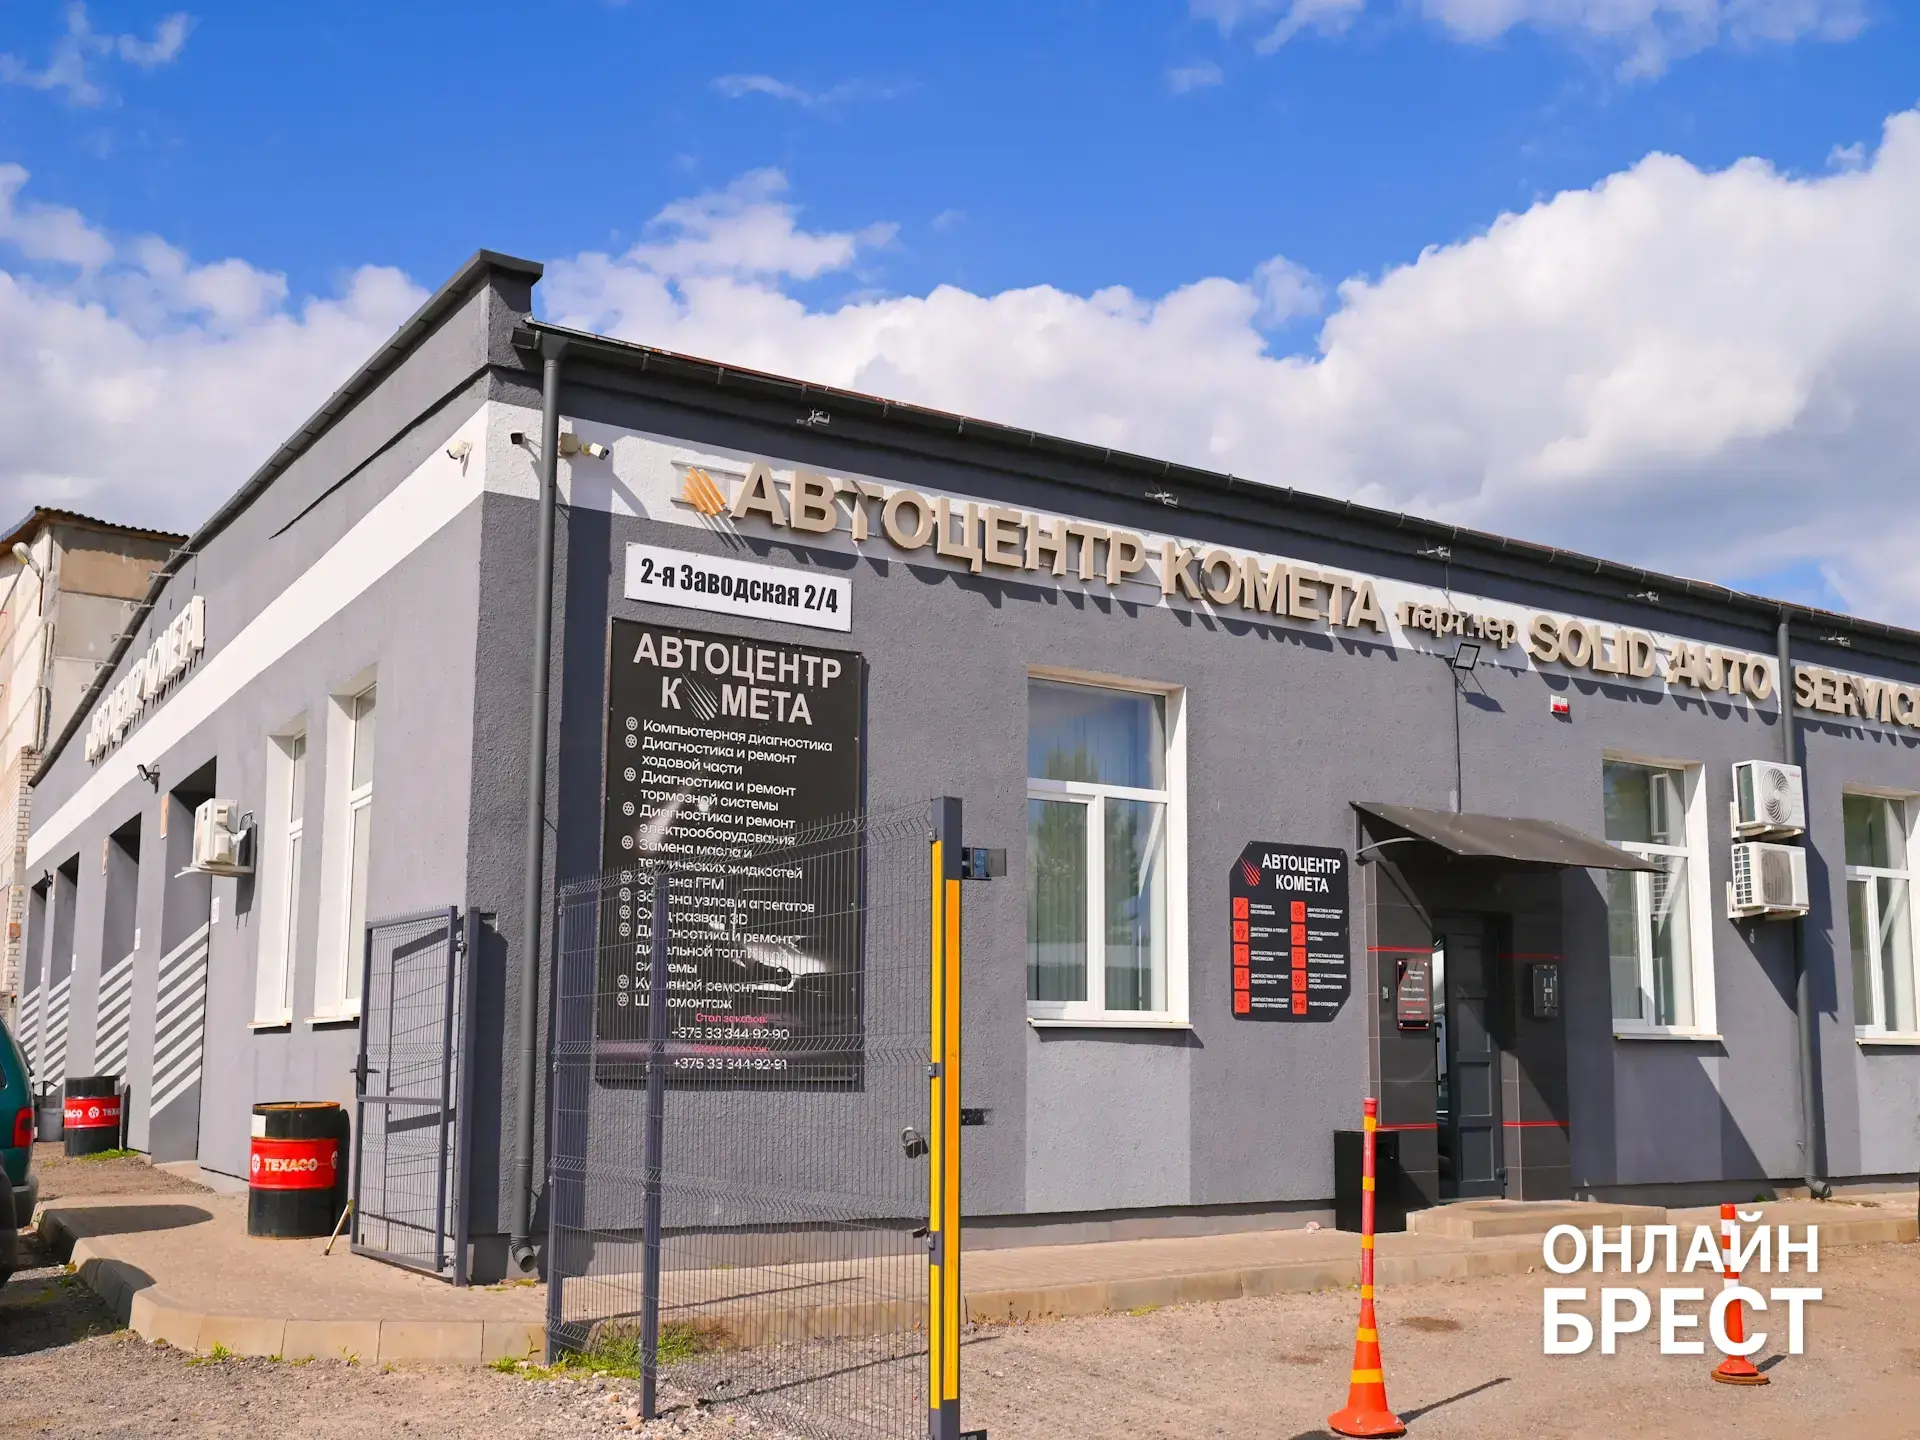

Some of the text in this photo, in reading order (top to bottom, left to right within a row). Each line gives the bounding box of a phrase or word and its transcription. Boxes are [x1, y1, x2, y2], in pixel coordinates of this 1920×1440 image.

[641, 558, 838, 613] 2-я Заводская 2/4
[729, 462, 1146, 586] АВТОЦЕНТР
[1162, 541, 1388, 633] КОМЕТА
[1396, 601, 1518, 650] партнер
[1529, 614, 1657, 679] SOLID
[1666, 641, 1772, 700] AUTO
[633, 633, 842, 689] АВТОЦЕНТР
[643, 719, 833, 752] Компьютерная диагностика
[642, 736, 797, 765] Диагностика и ремонт
[642, 754, 743, 775] ходовой части
[641, 770, 796, 797] Диагностика и ремонт
[641, 789, 779, 812] тормозной системы
[639, 804, 796, 830] Диагностика и ремонт
[639, 824, 795, 846] электрооборудования
[639, 838, 694, 855] Замена
[728, 864, 803, 879] жидкостей
[1262, 853, 1341, 875] АВТОЦЕНТР
[638, 872, 724, 891] Заена ГРМ
[1276, 874, 1329, 893] КОМЕТА
[637, 889, 691, 905] Заена
[694, 894, 735, 908] узлов
[749, 899, 815, 913] агрегатов
[636, 924, 729, 941] Дигностика
[743, 933, 794, 945] ремонт
[636, 945, 712, 959] диельной
[636, 962, 697, 974] сиемы
[636, 977, 702, 991] Кувной
[635, 994, 732, 1009] Шомонтаж
[696, 1013, 721, 1022] Стол
[264, 1158, 318, 1172] TEXACO
